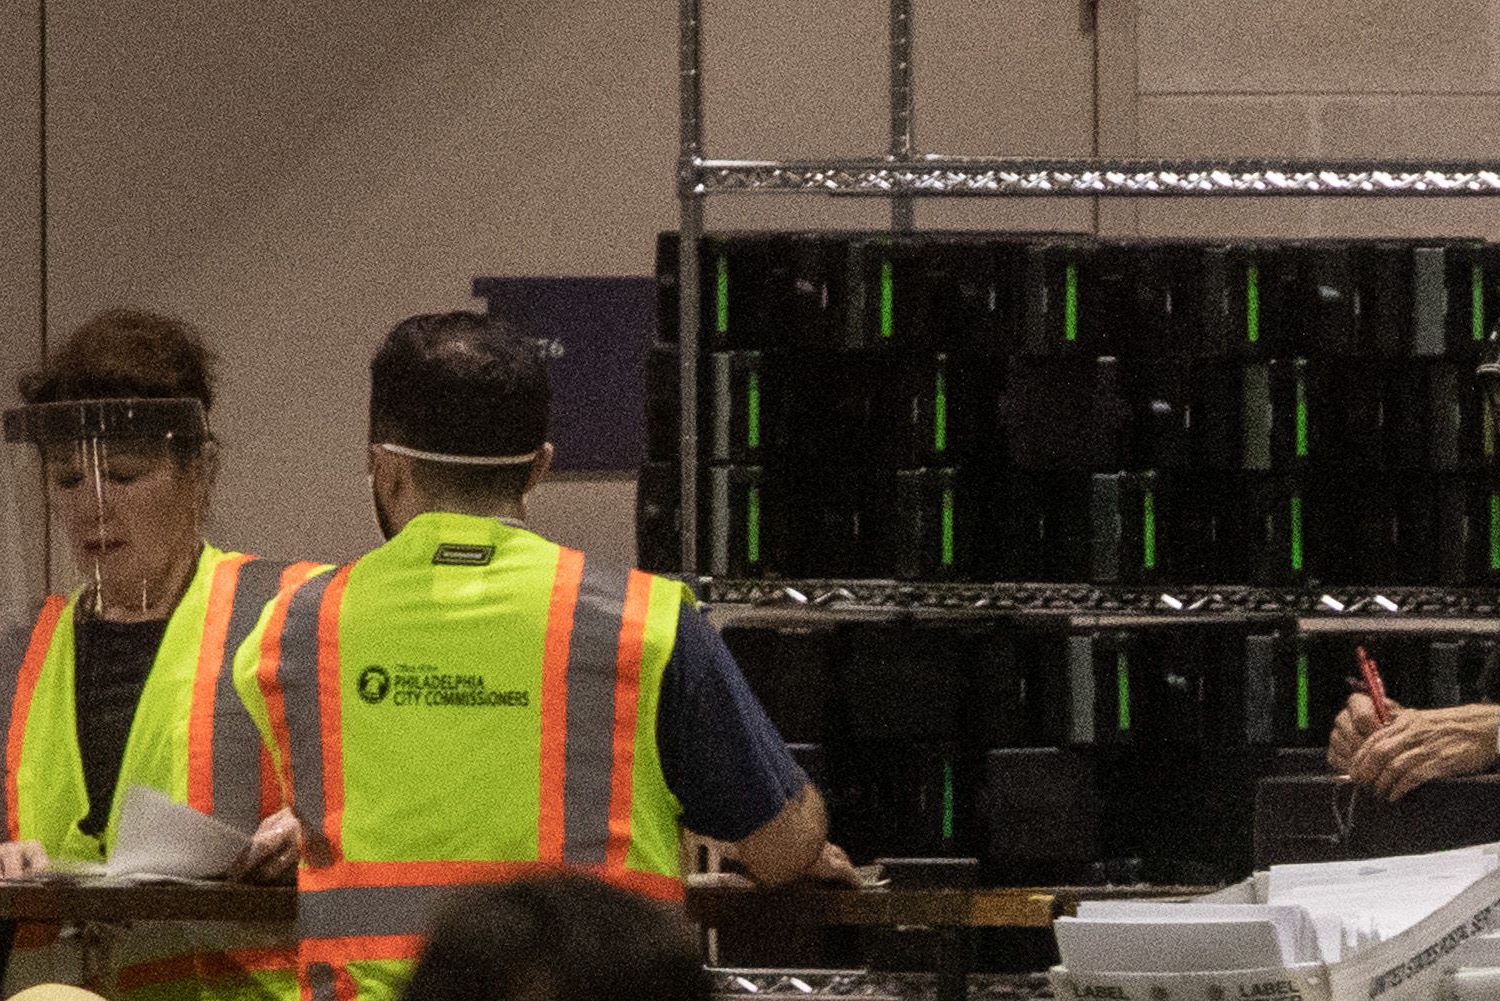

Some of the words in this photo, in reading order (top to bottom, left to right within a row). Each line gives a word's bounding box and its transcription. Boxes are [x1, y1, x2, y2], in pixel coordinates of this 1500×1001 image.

[394, 675, 484, 690] PHILADELPHIA
[393, 690, 422, 706] CITY
[425, 690, 529, 707] COMMISSIONERS
[1074, 985, 1130, 999] LABEL
[1239, 981, 1300, 997] LABEL
